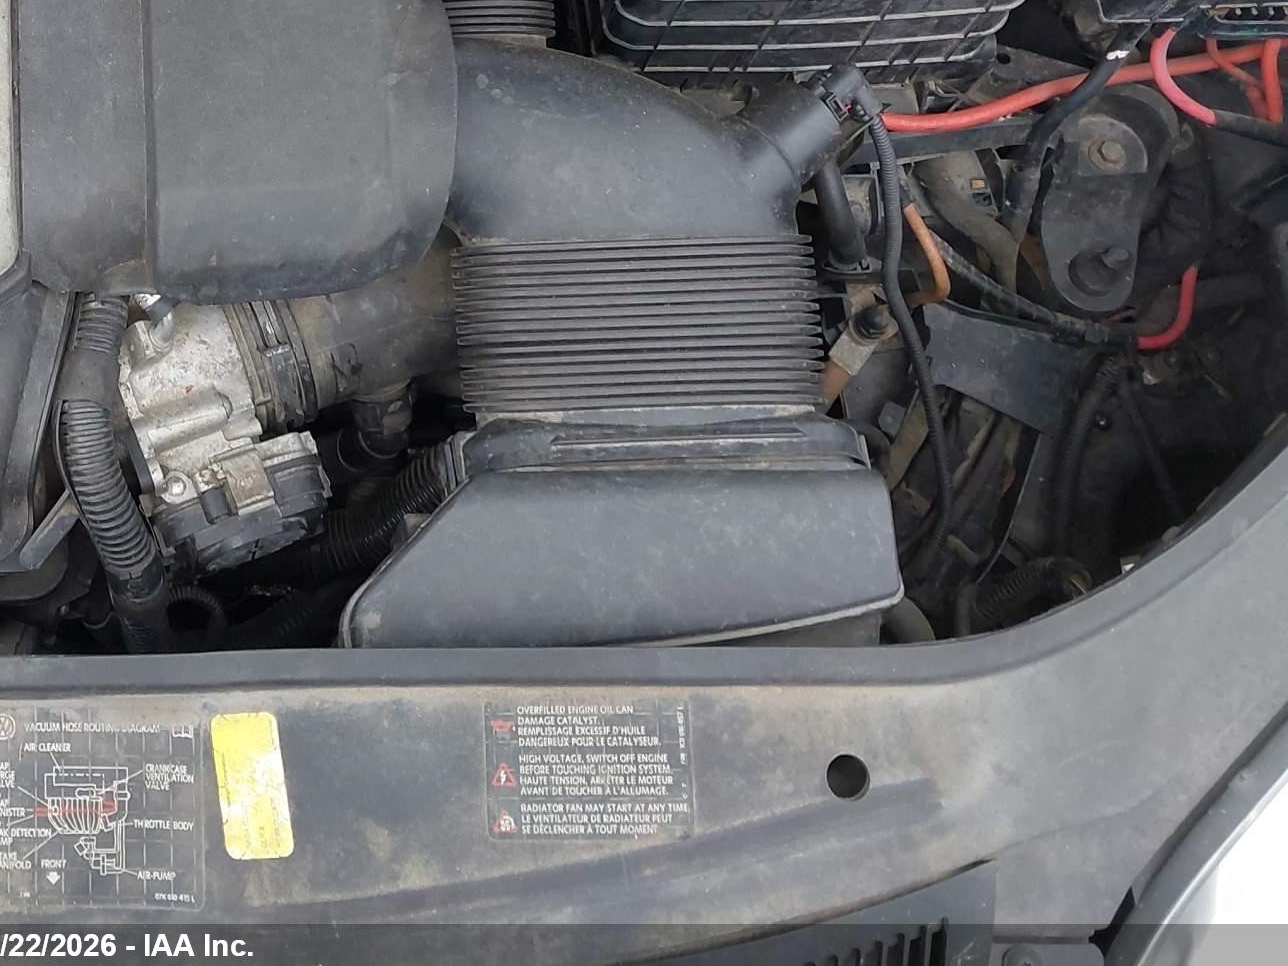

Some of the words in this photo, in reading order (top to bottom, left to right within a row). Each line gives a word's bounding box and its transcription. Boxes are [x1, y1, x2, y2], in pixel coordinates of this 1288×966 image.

[517, 706, 566, 715] OVERFILLED
[568, 706, 599, 715] ENGINE
[600, 706, 614, 715] OIL
[616, 706, 634, 715] CAN
[518, 716, 555, 725] DAMAGE
[518, 726, 573, 735] REMPLISSAGE
[575, 726, 610, 735] EXCESSIF
[519, 737, 569, 746] DANGEREUX
[572, 737, 593, 746] POUR
[596, 737, 605, 746] LE
[24, 743, 36, 752] AIR
[38, 743, 71, 752] CLEANER
[519, 754, 541, 763] HIGH
[586, 754, 618, 763] SWITCH
[620, 754, 635, 763] OFF
[637, 754, 668, 763] ENGINE
[145, 764, 187, 773] CRANKCASE
[520, 765, 549, 774] BEFORE
[552, 765, 596, 774] TOUCHING
[599, 765, 636, 774] IGNITION
[145, 773, 194, 783] VENTILATION
[520, 776, 548, 785] HAUTE
[627, 776, 637, 785] LE
[638, 776, 673, 785] MOTEUR
[145, 781, 169, 790] VALVE
[520, 786, 549, 795] AVANT
[552, 786, 563, 795] DE
[565, 786, 603, 795] TOUCHER
[520, 803, 564, 812] RADIATOR
[566, 803, 583, 812] FAN
[585, 803, 604, 812] MAY
[607, 803, 632, 812] START
[635, 803, 645, 812] AT
[648, 803, 665, 812] ANY
[521, 814, 530, 823] LE
[532, 814, 588, 823] VENTILATEUR
[591, 814, 601, 823] DE
[603, 814, 650, 823] RADIATEUR
[652, 814, 672, 823] PEUT
[133, 819, 170, 829] THROTTLE
[173, 821, 194, 831] BODY
[522, 825, 531, 834] SE
[595, 825, 618, 834] TOUT
[11, 828, 52, 837] DETECTION
[41, 860, 67, 869] FRONT
